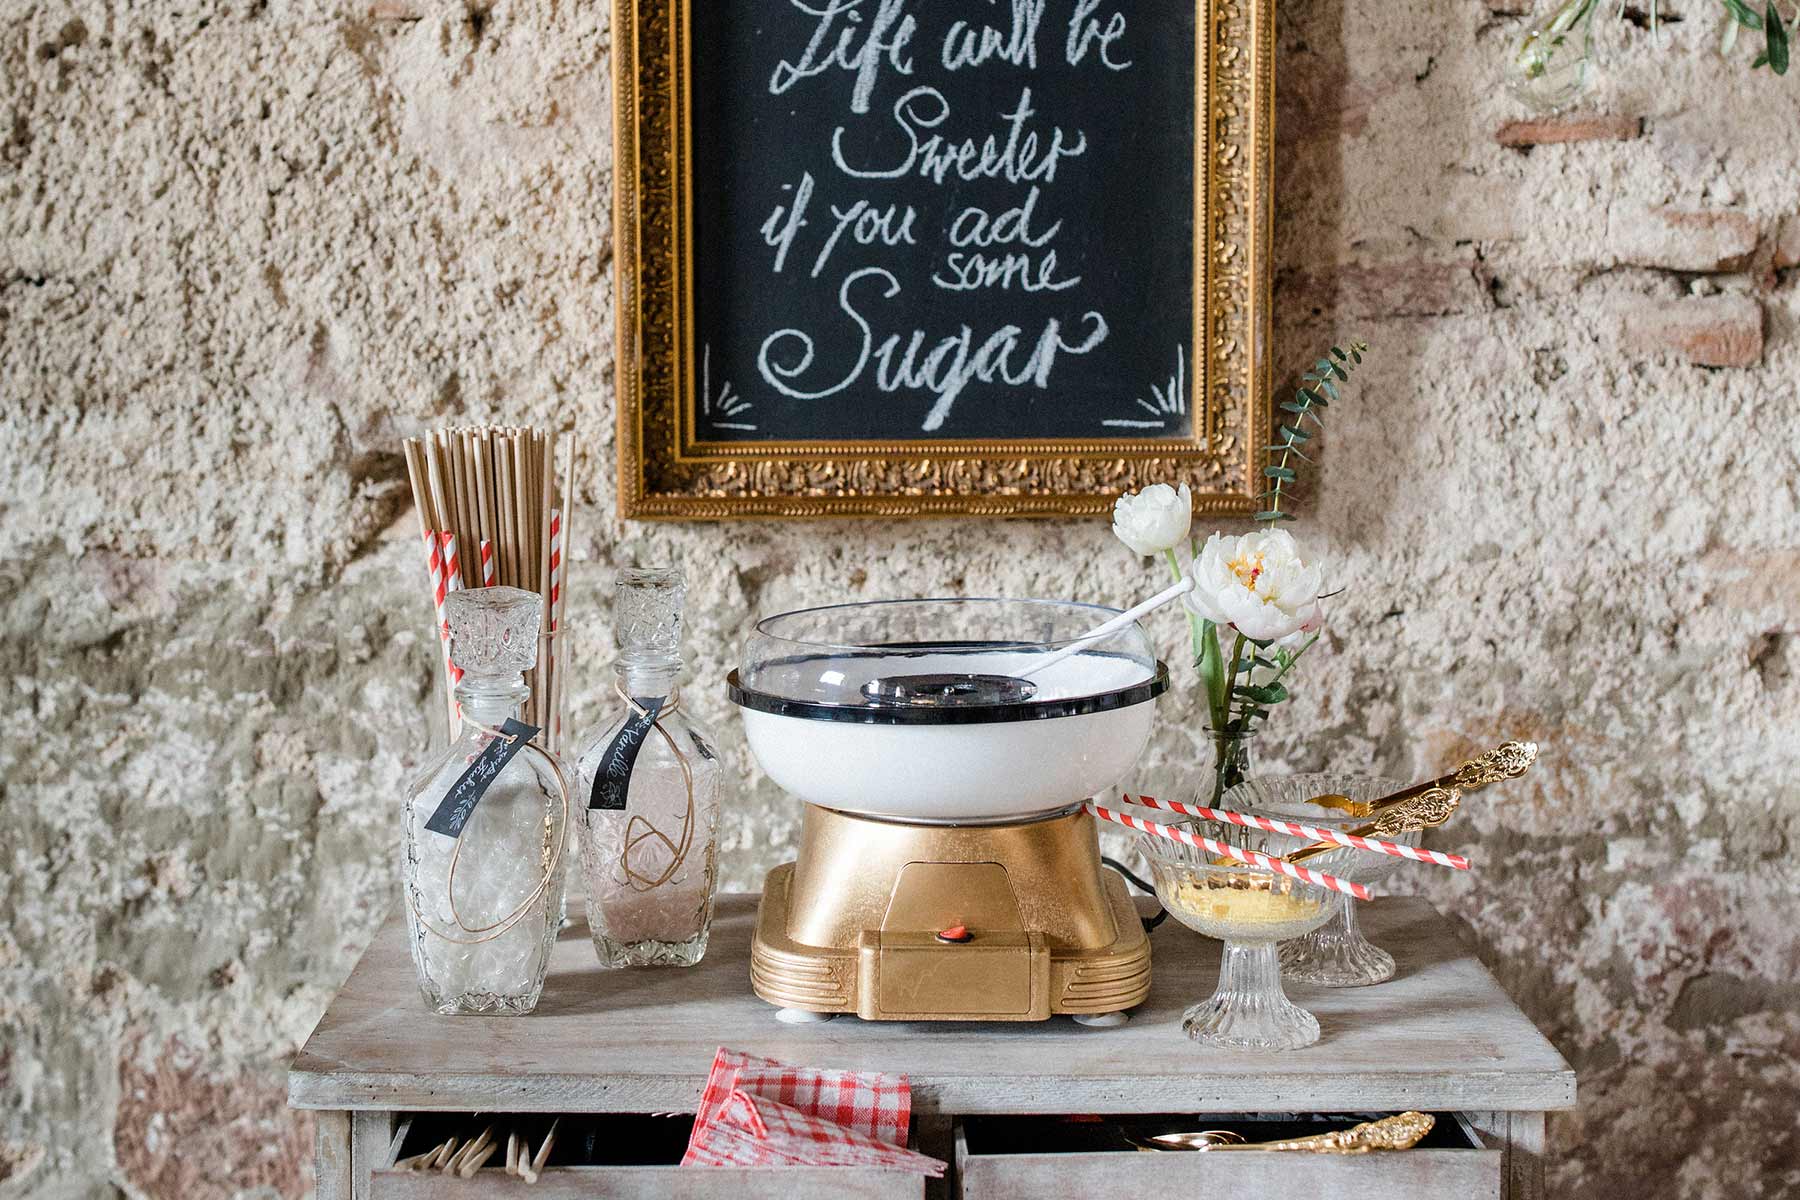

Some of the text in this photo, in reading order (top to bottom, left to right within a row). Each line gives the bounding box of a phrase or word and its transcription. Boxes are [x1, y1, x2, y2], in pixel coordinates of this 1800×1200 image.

[769, 0, 1132, 114] Life will be
[831, 86, 1087, 184] Sweeter
[760, 171, 1064, 278] if you ad
[932, 248, 1081, 292] some
[757, 266, 1110, 431] Sugar
[606, 728, 639, 779] Vanille
